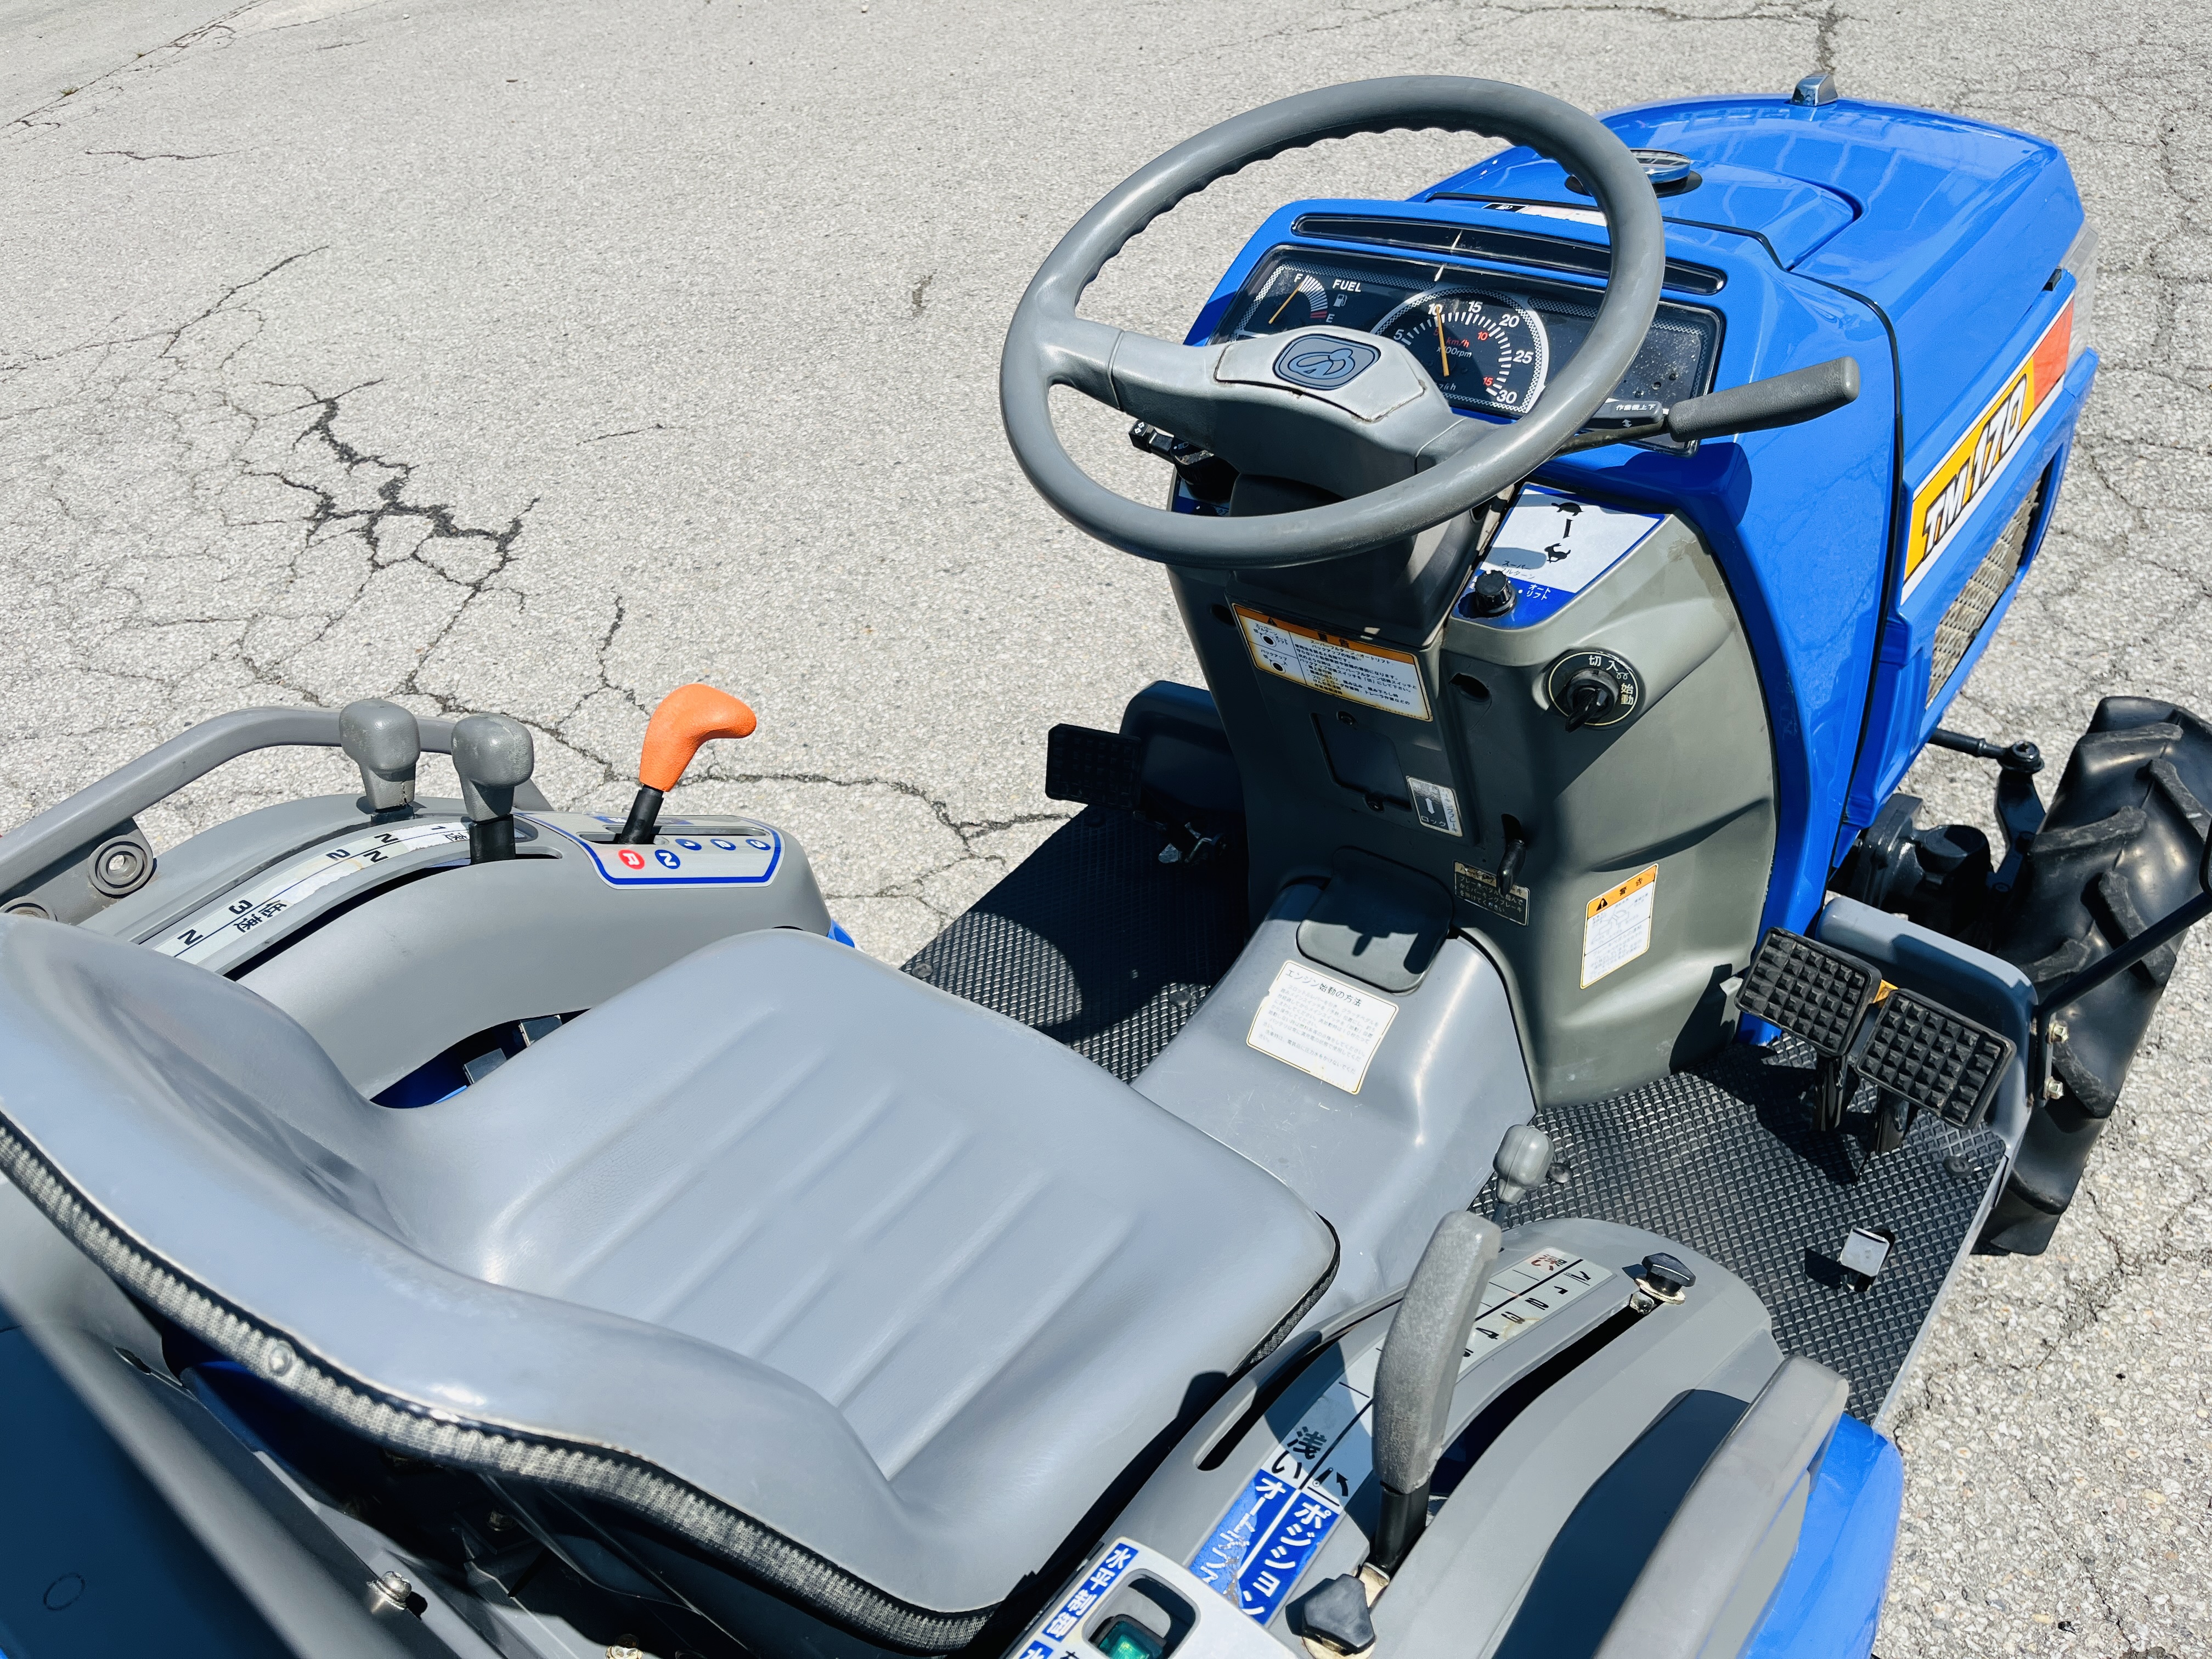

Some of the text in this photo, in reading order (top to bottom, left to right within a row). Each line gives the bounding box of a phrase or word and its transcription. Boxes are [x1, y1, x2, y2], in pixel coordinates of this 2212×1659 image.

[1294, 274, 1303, 283] F
[1332, 279, 1362, 292] FUEL
[1428, 303, 1443, 316] 10
[1468, 301, 1483, 313] 15
[1325, 313, 1335, 323] E
[1498, 314, 1520, 328] 20
[1393, 329, 1404, 341] 5
[1477, 331, 1488, 341] 10
[1446, 337, 1470, 348] km/h
[1436, 346, 1472, 358] x00rpm
[1513, 350, 1534, 364] 25
[1483, 376, 1493, 386] 15
[1496, 390, 1517, 404] 30
[1526, 590, 1548, 601] リフト
[1528, 584, 1551, 594] オート
[1588, 654, 1601, 667] 切
[1606, 660, 1618, 672] 入
[1621, 682, 1634, 706] 始動
[1421, 815, 1446, 827] ロック
[326, 849, 351, 861] 2
[1459, 875, 1523, 906] ブレーキペダル踏んで
[1620, 877, 1643, 896] 警告
[228, 899, 253, 915] 3
[233, 899, 287, 933] 低速
[1285, 969, 1362, 1007] エンジン始動の方法
[1553, 1285, 1568, 1295] 1
[1524, 1297, 1549, 1311] 2
[1500, 1311, 1525, 1324] 3
[1475, 1327, 1499, 1340] 4
[1272, 1426, 1328, 1480] 浅い
[1242, 1502, 1332, 1616] ポジション
[1046, 1547, 1128, 1638] 水平制御
